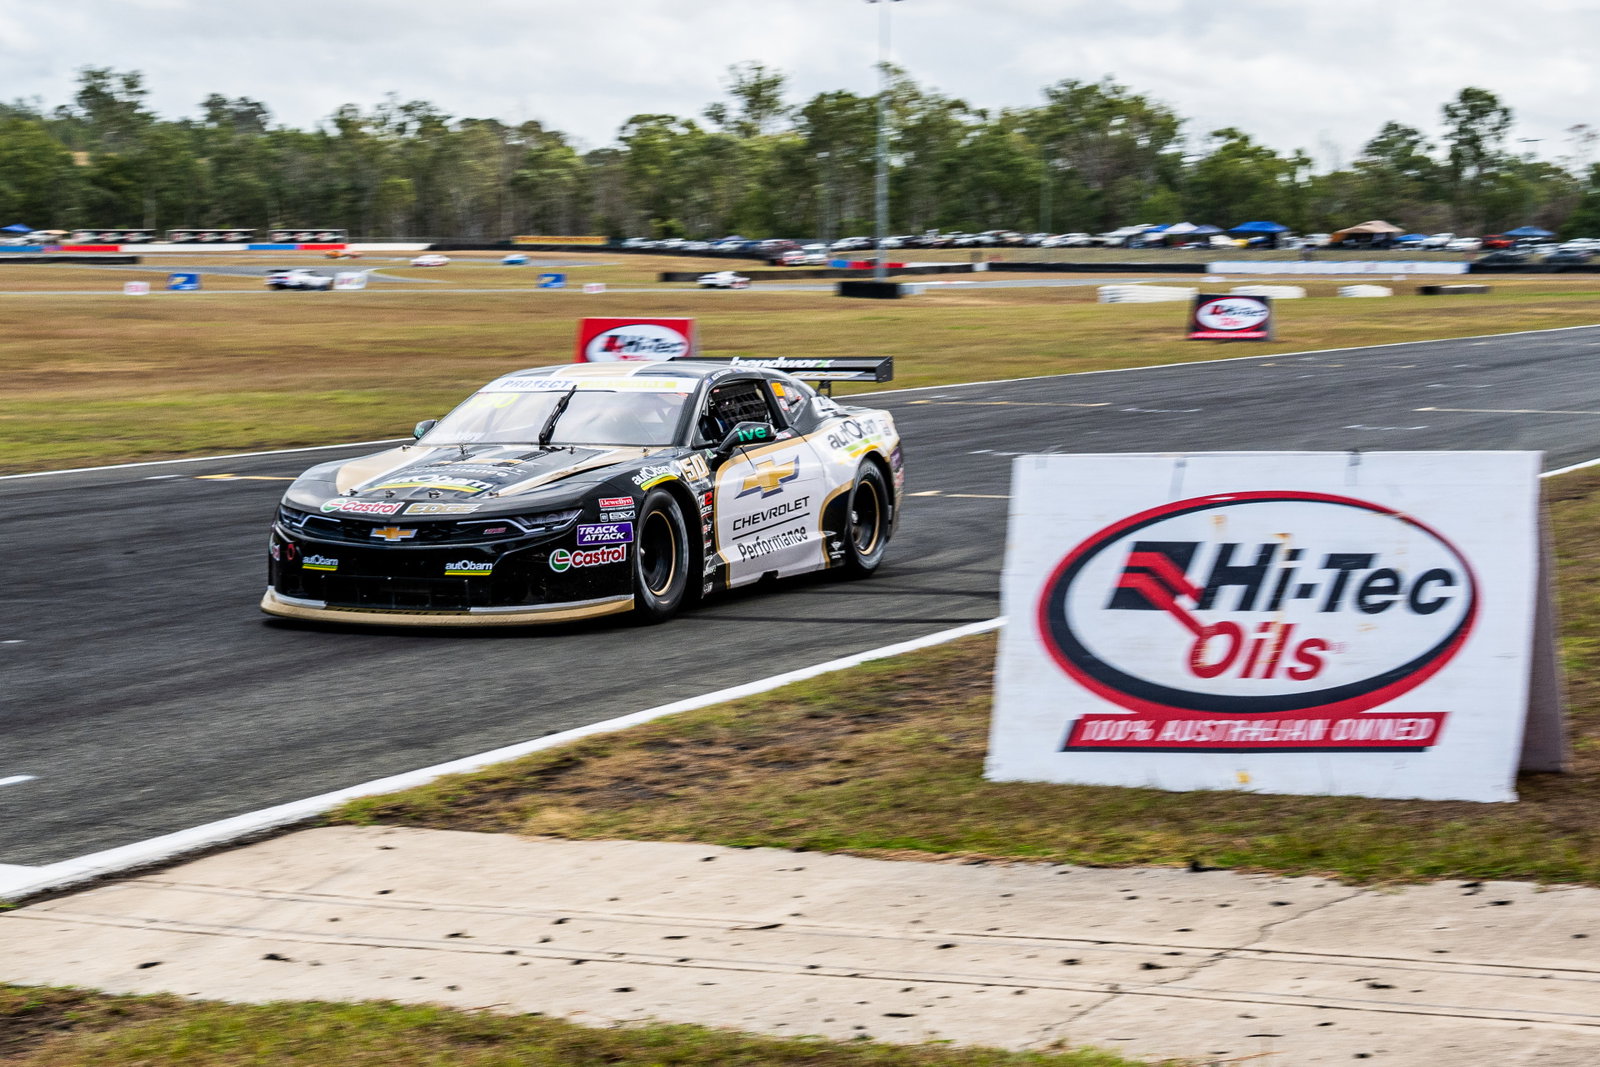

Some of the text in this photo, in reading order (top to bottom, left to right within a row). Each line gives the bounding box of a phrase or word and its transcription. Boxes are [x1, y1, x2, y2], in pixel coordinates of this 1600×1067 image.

[342, 501, 479, 513] Castrol EDGE
[732, 496, 810, 531] CHEVROLET
[579, 525, 620, 534] TRACK
[582, 532, 626, 542] ATTACK
[738, 525, 808, 563] Performance
[302, 554, 338, 566] autObarn
[445, 560, 493, 570] autObarn
[571, 545, 626, 567] Castrol
[1197, 542, 1458, 615] Hi-Tec
[1187, 621, 1332, 681] Oils
[1080, 717, 1436, 743] 100% AUSTRALIAN OWNED
